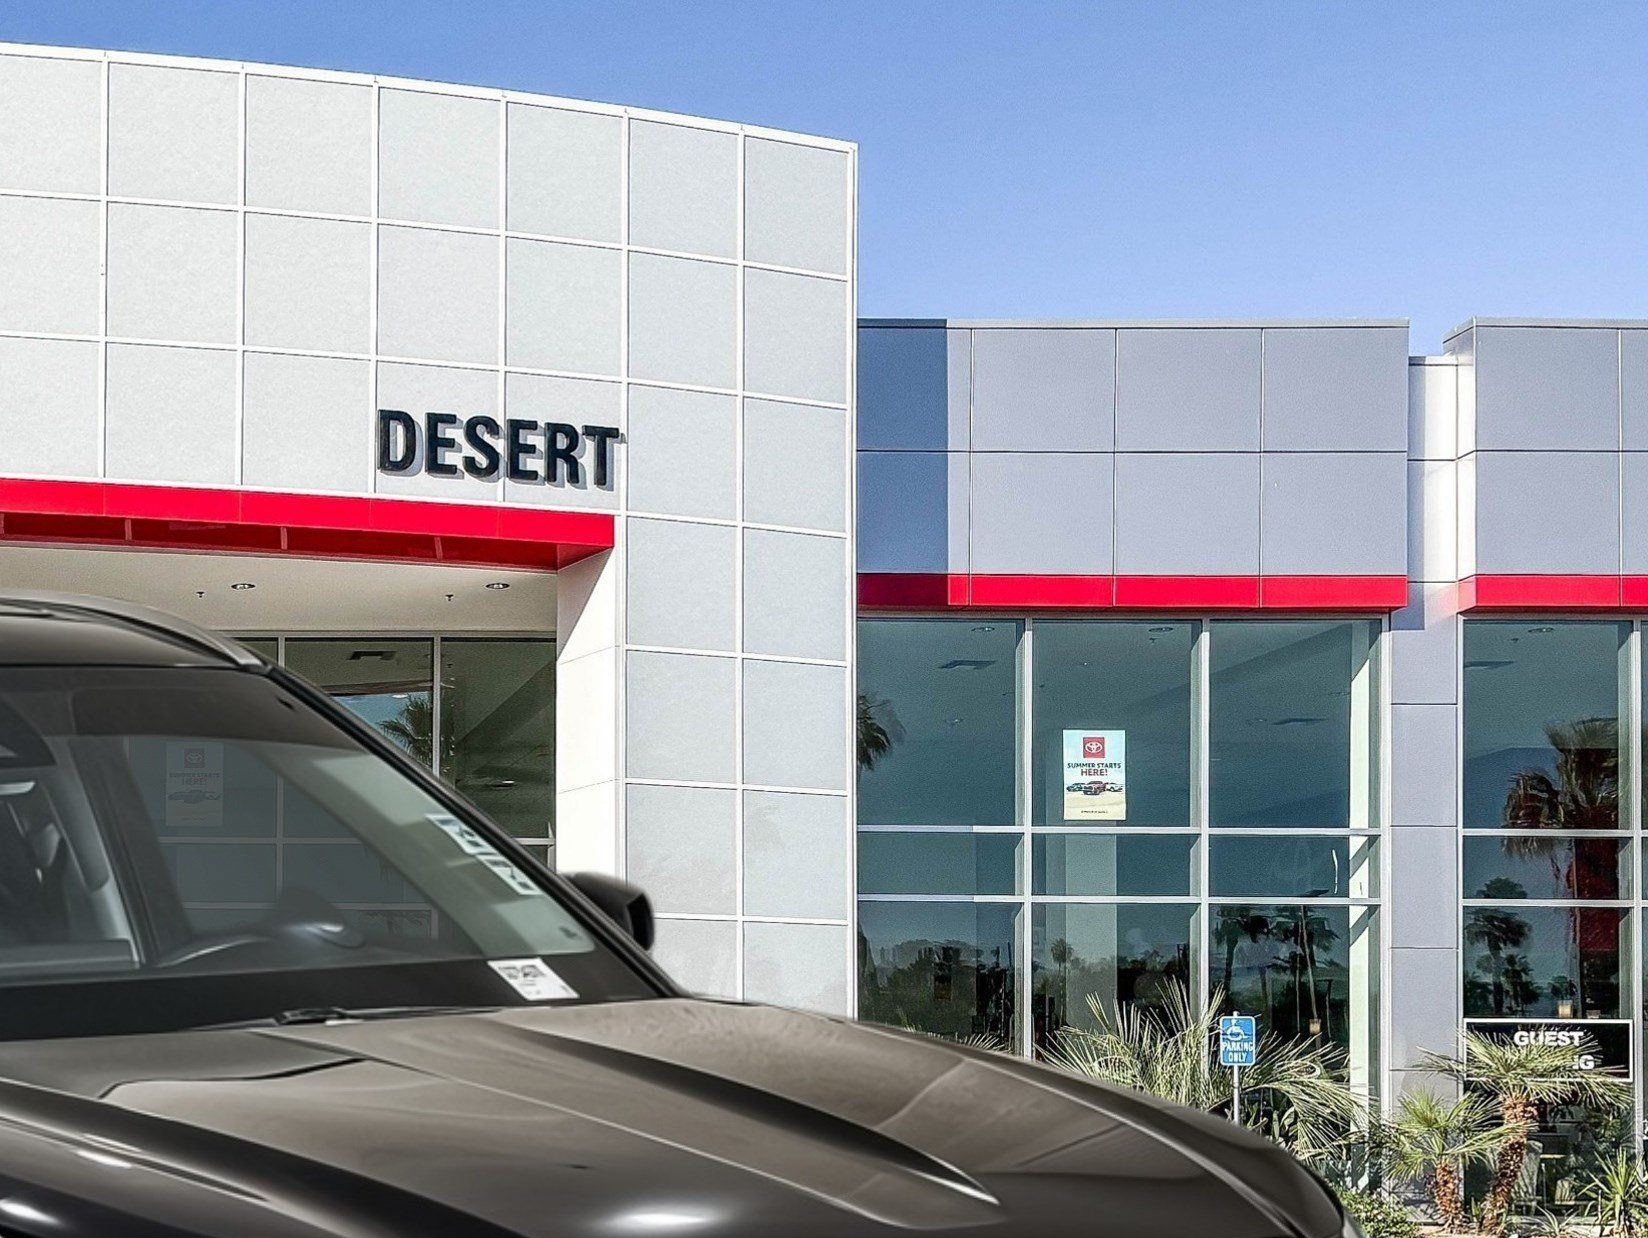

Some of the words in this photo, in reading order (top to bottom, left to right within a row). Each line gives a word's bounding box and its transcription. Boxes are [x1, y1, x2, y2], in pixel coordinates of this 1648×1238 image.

[377, 409, 620, 487] DESERT
[1080, 768, 1108, 776] HERE!
[1513, 1031, 1585, 1047] GUEST
[1222, 1041, 1253, 1052] PARKING
[1228, 1052, 1247, 1062] ONLY
